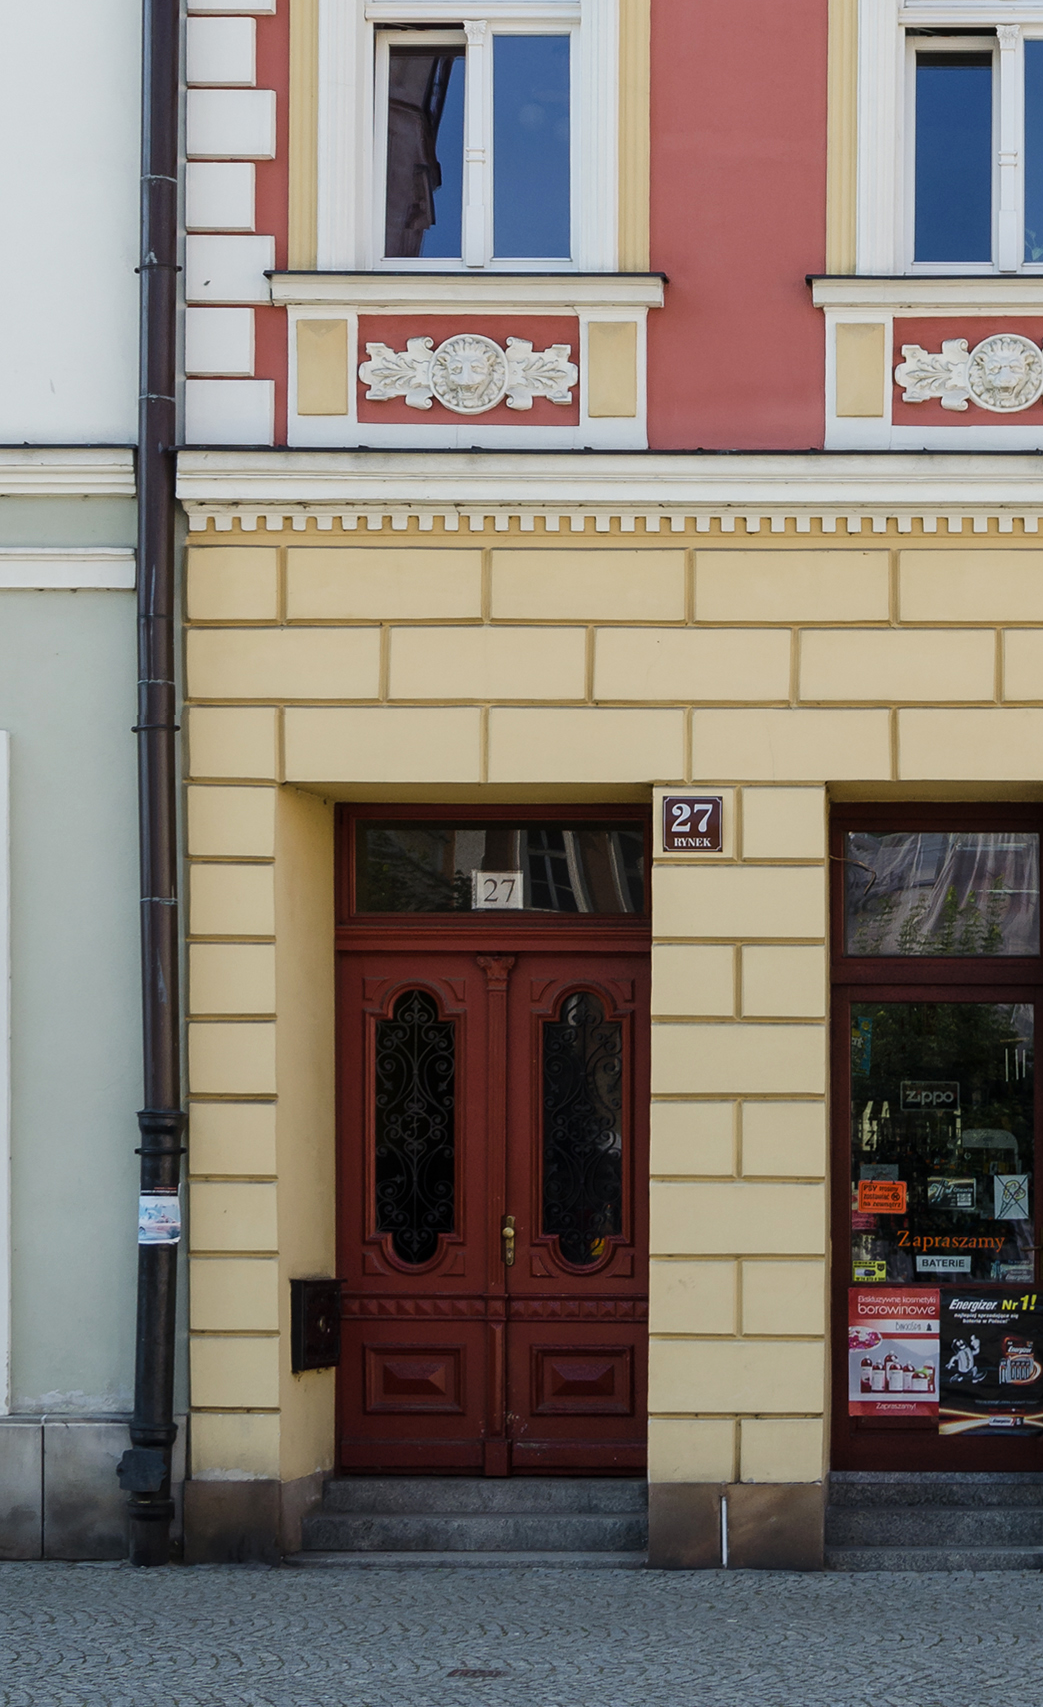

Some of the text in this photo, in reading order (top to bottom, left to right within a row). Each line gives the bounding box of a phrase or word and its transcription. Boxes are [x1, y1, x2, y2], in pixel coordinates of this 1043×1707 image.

[671, 803, 713, 833] 27
[674, 837, 712, 847] RYNEK
[483, 879, 515, 902] 27
[896, 1230, 1005, 1252] Zapraszamy
[922, 1259, 965, 1268] BATERIE
[858, 1296, 936, 1305] Ekskluzywne kosmetyki
[949, 1294, 1037, 1312] Energizer Nr 1!
[858, 1304, 936, 1315] borowinowe
[876, 1402, 916, 1410] Zapraszamy!
